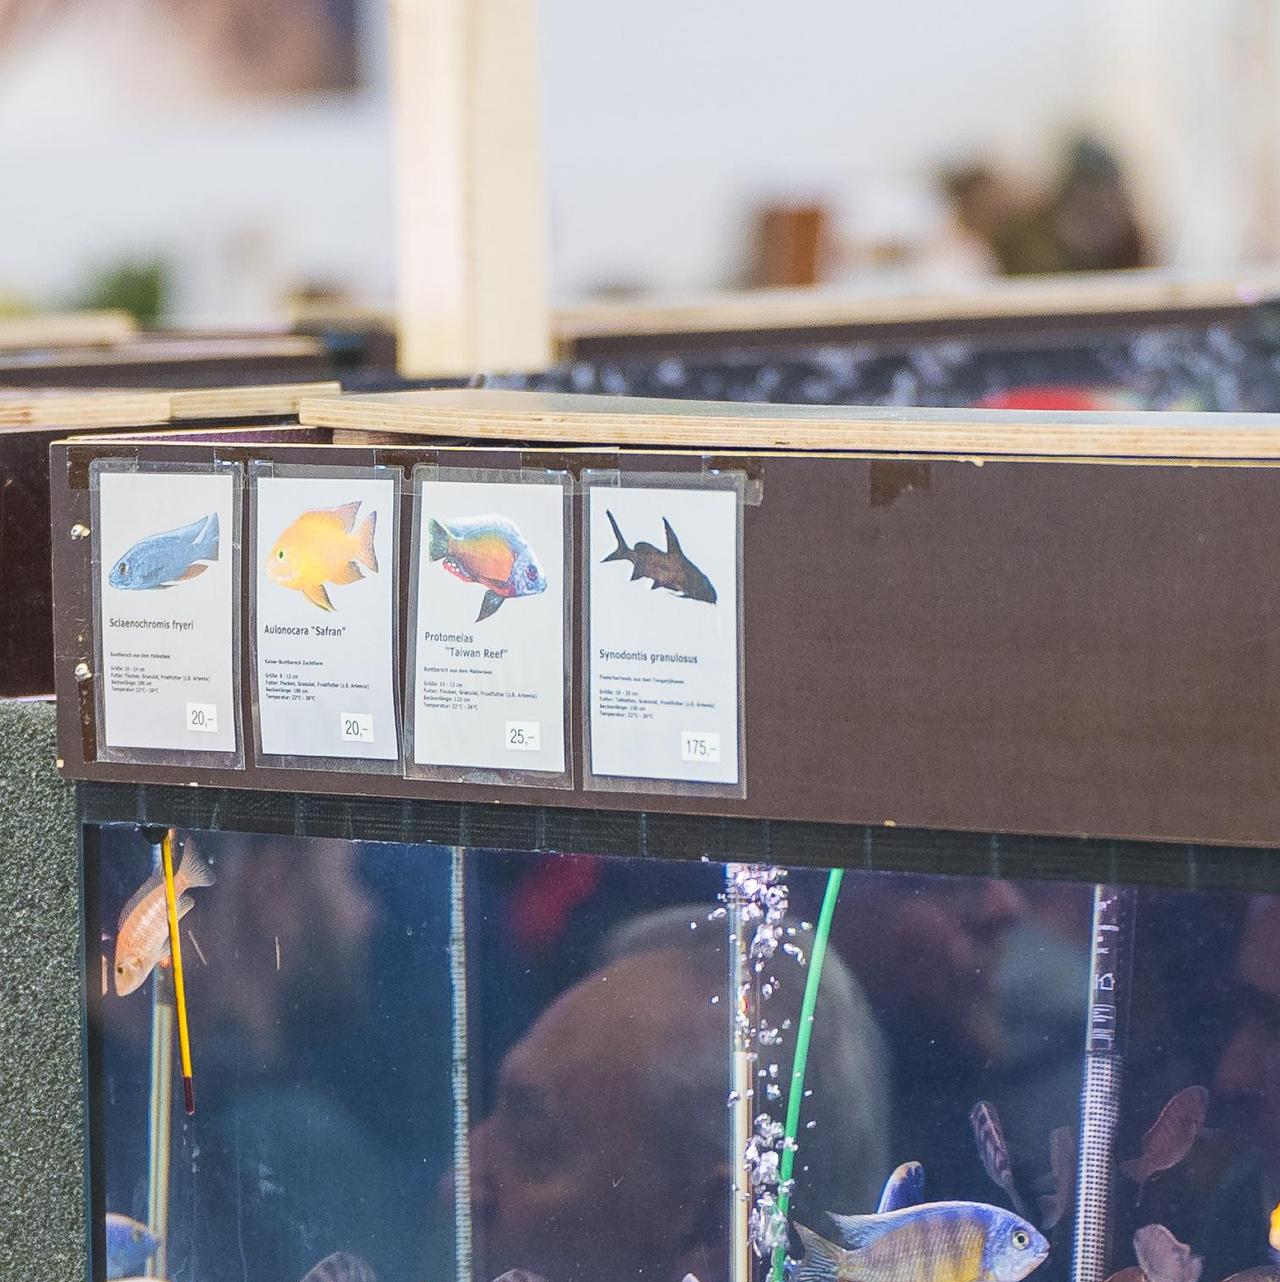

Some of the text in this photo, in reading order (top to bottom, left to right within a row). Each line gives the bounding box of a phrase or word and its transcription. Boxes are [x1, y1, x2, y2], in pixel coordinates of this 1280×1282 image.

[264, 625, 309, 636] Aulonocara
[425, 632, 473, 643] Protomelas
[599, 648, 698, 664] Synodontis granulosus
